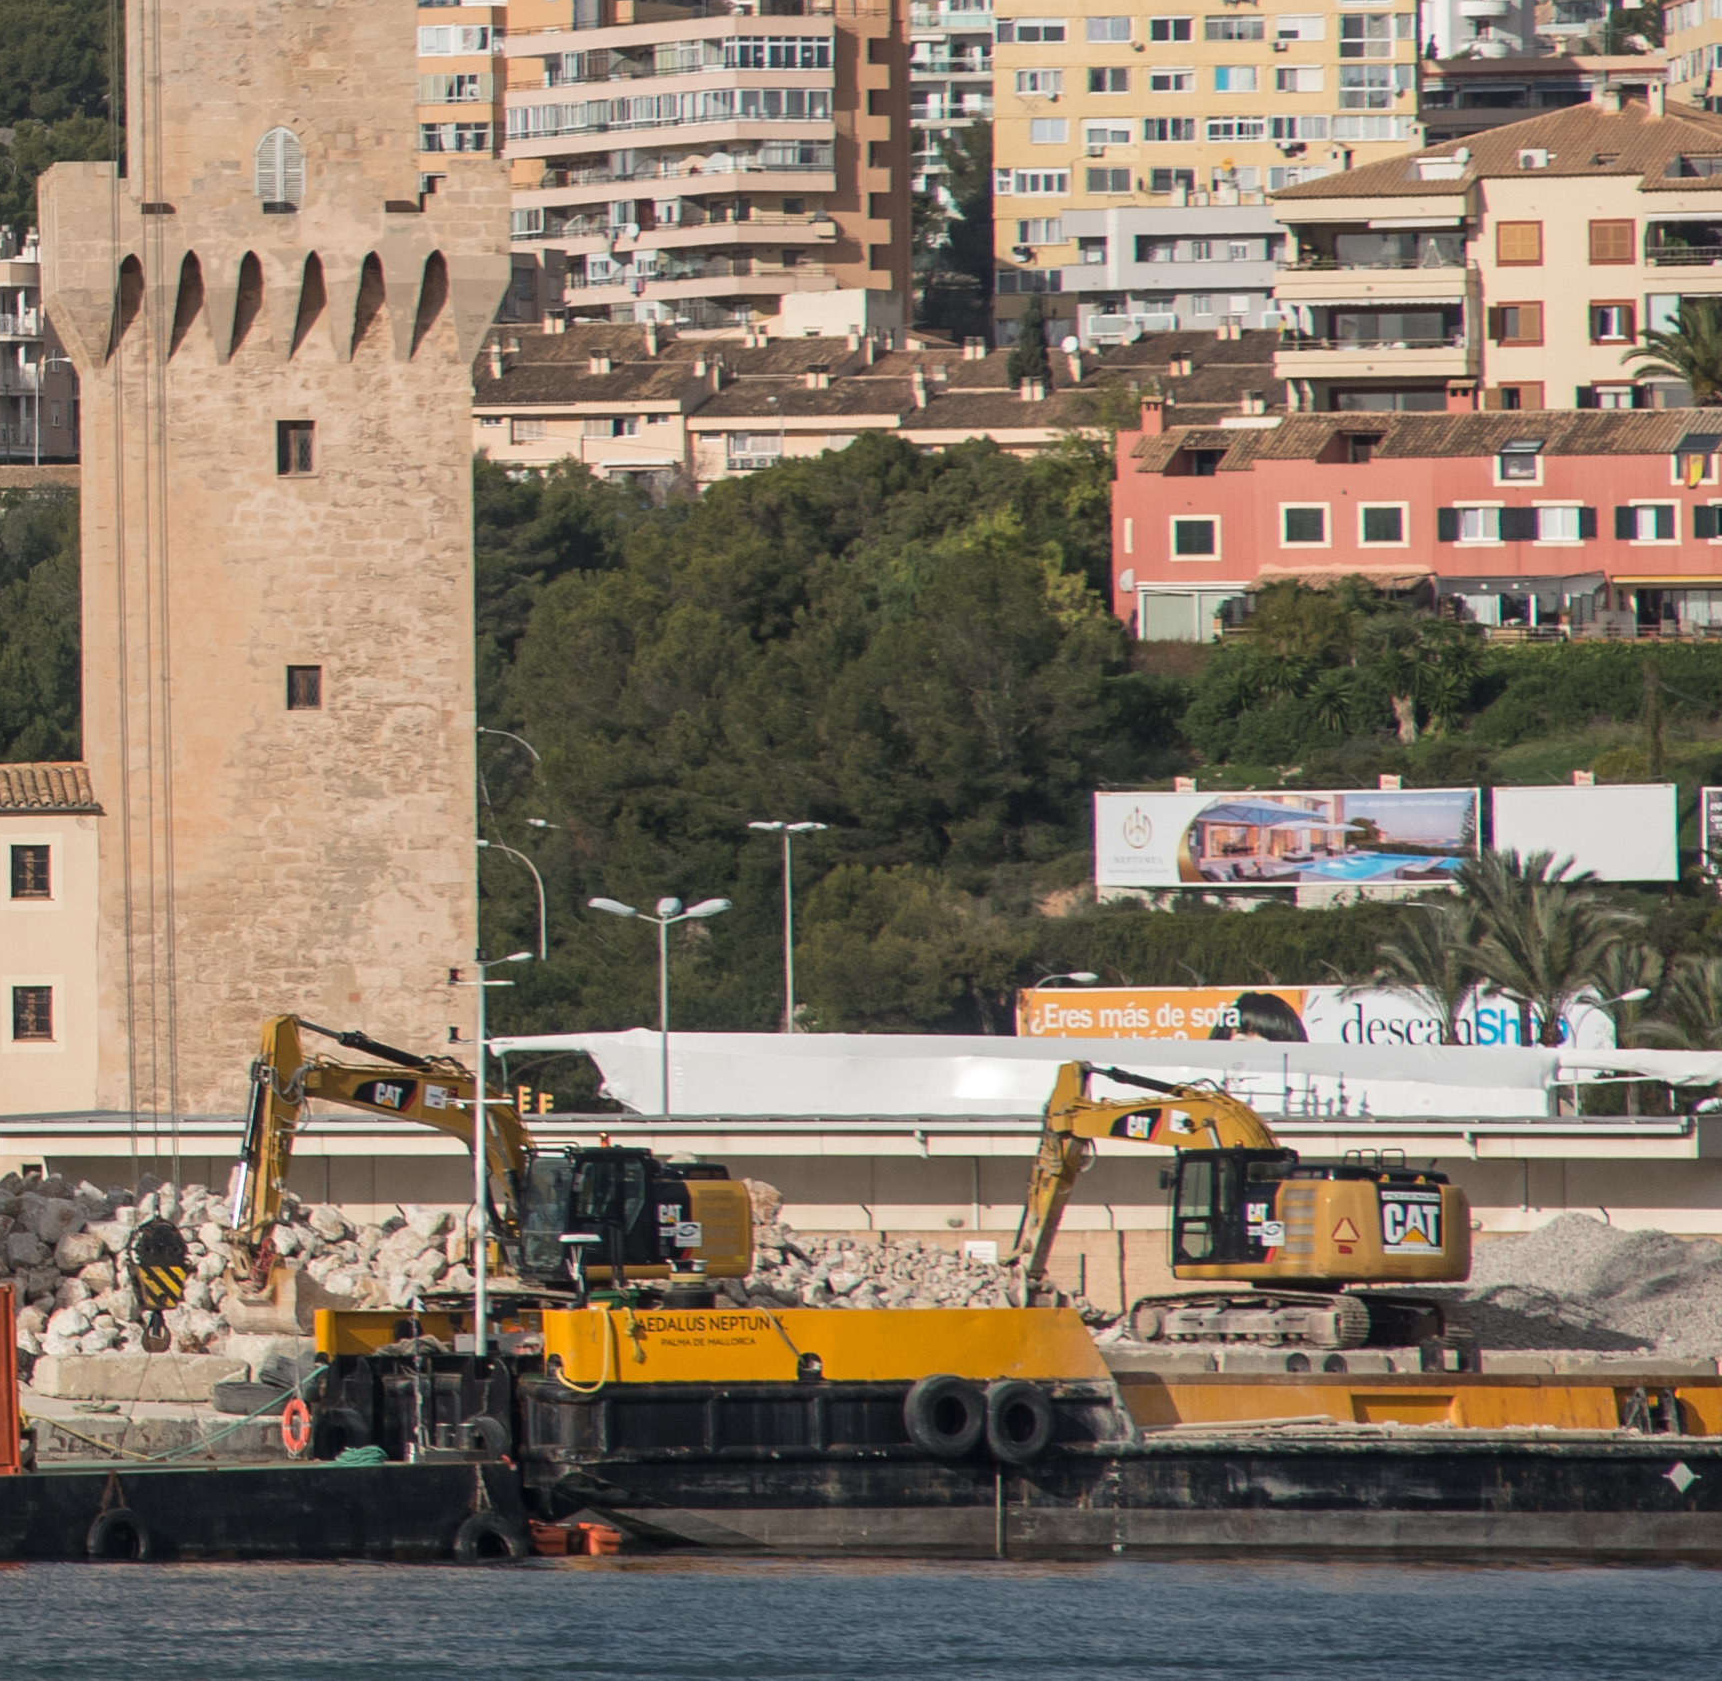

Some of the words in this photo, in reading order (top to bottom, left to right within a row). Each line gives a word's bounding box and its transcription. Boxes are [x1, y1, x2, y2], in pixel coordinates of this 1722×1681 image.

[1030, 1003, 1093, 1035] ¿Eres
[1099, 1001, 1151, 1028] más
[1156, 1002, 1185, 1027] de
[1190, 1000, 1241, 1028] sofá
[374, 1082, 403, 1109] CAT
[1126, 1115, 1151, 1138] CAT
[658, 1204, 682, 1223] CAT
[1248, 1203, 1268, 1222] CAT
[1383, 1203, 1440, 1245] CAT
[638, 1316, 706, 1332] AEDALUS
[661, 1338, 691, 1346] PALMA
[693, 1338, 705, 1346] DE
[707, 1337, 756, 1346] MALLORCA
